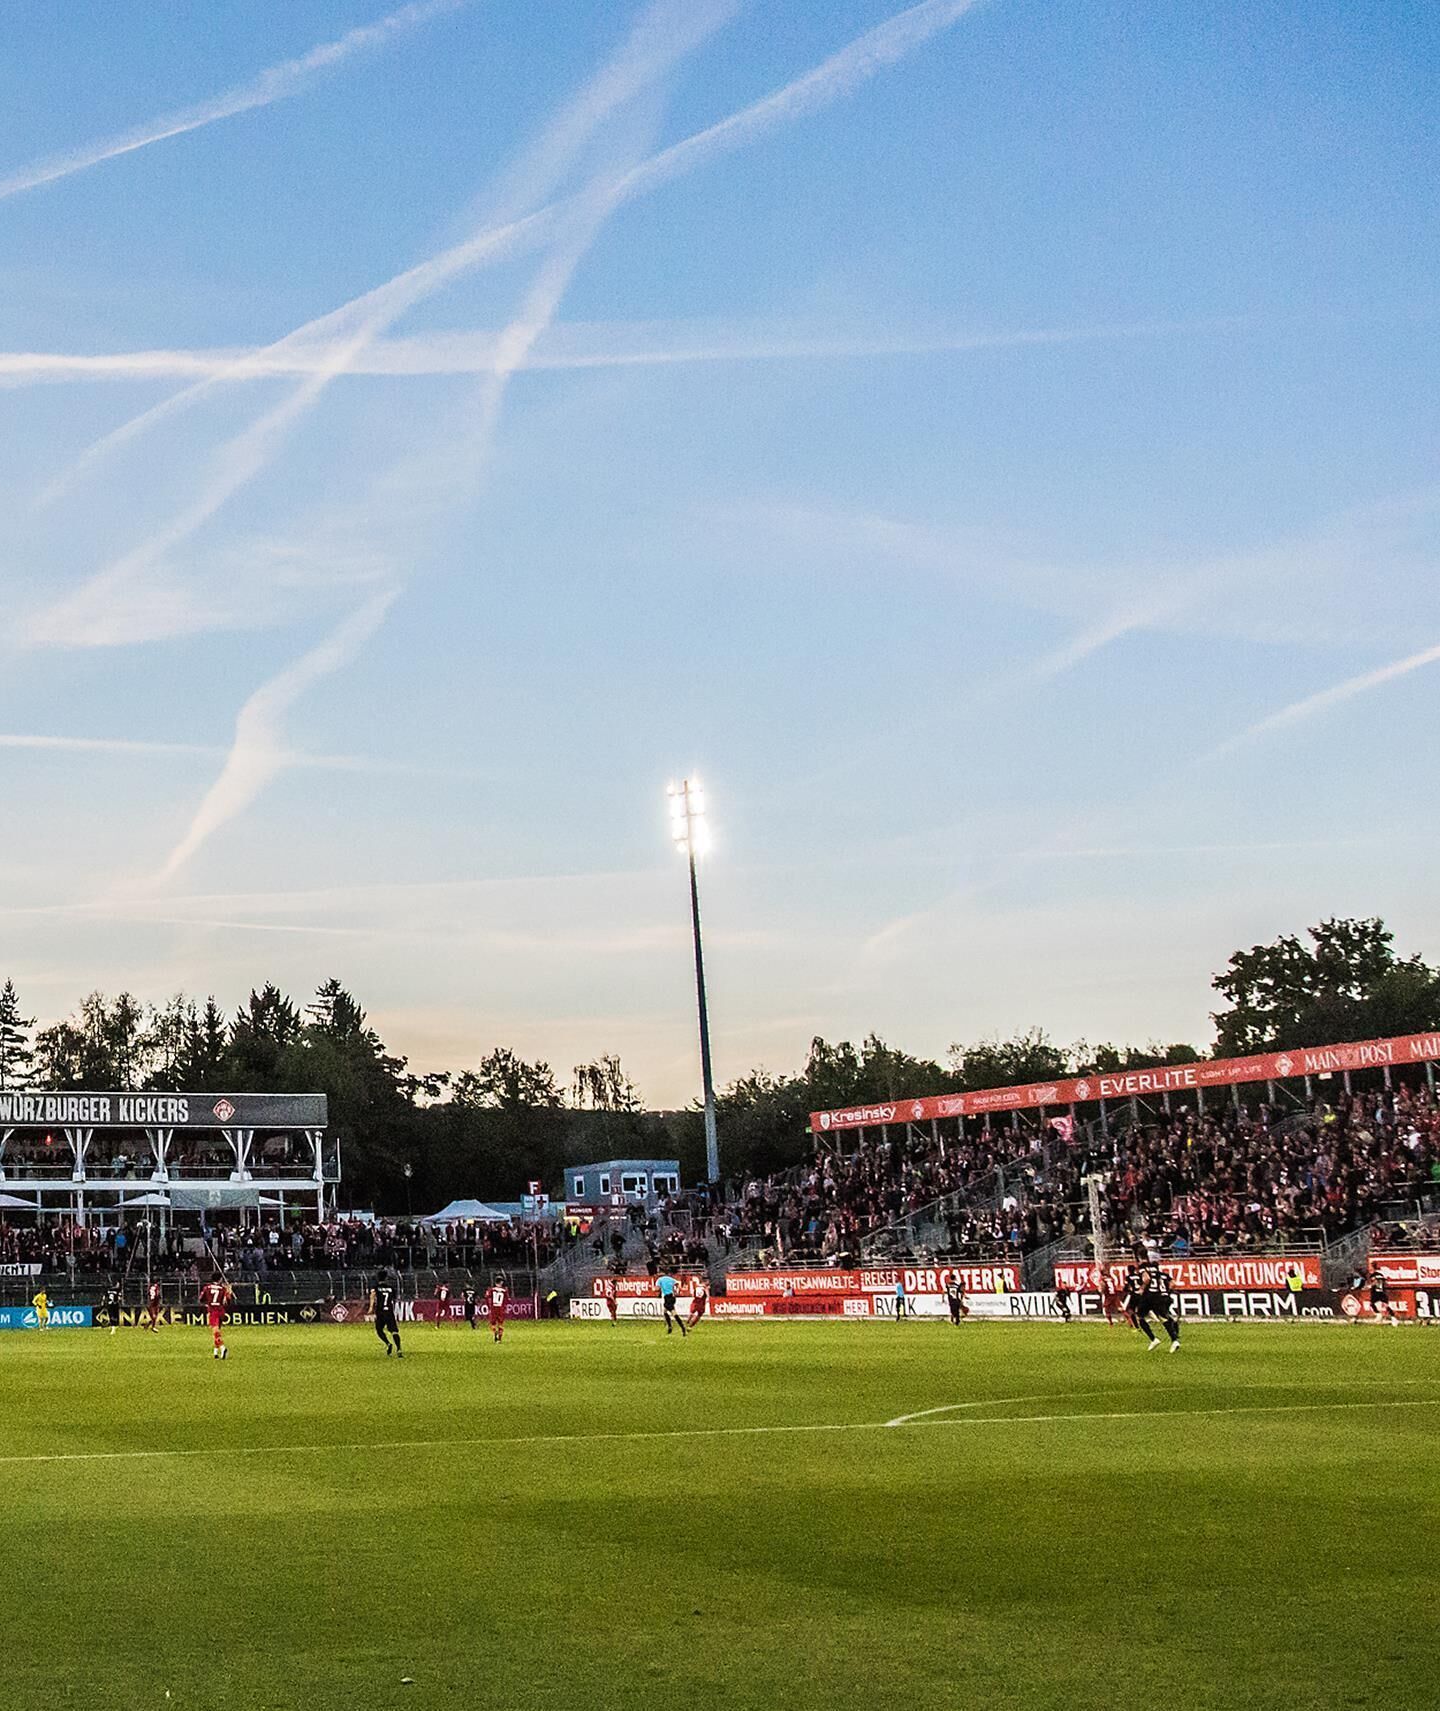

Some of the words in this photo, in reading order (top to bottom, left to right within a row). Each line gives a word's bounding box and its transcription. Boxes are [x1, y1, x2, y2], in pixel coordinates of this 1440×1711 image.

[1305, 1050, 1340, 1071] MAIN
[1360, 1043, 1394, 1065] POST
[1100, 1069, 1197, 1096] EVERLITE
[118, 1098, 189, 1123] KICKERS
[530, 1181, 539, 1195] F
[904, 1270, 938, 1292] DER
[211, 1289, 220, 1303] 7
[382, 1292, 389, 1306] 7
[492, 1291, 505, 1305] 10
[582, 1303, 601, 1317] RED
[845, 1302, 867, 1314] HERZ
[186, 1311, 288, 1326] IMOBILIEN
